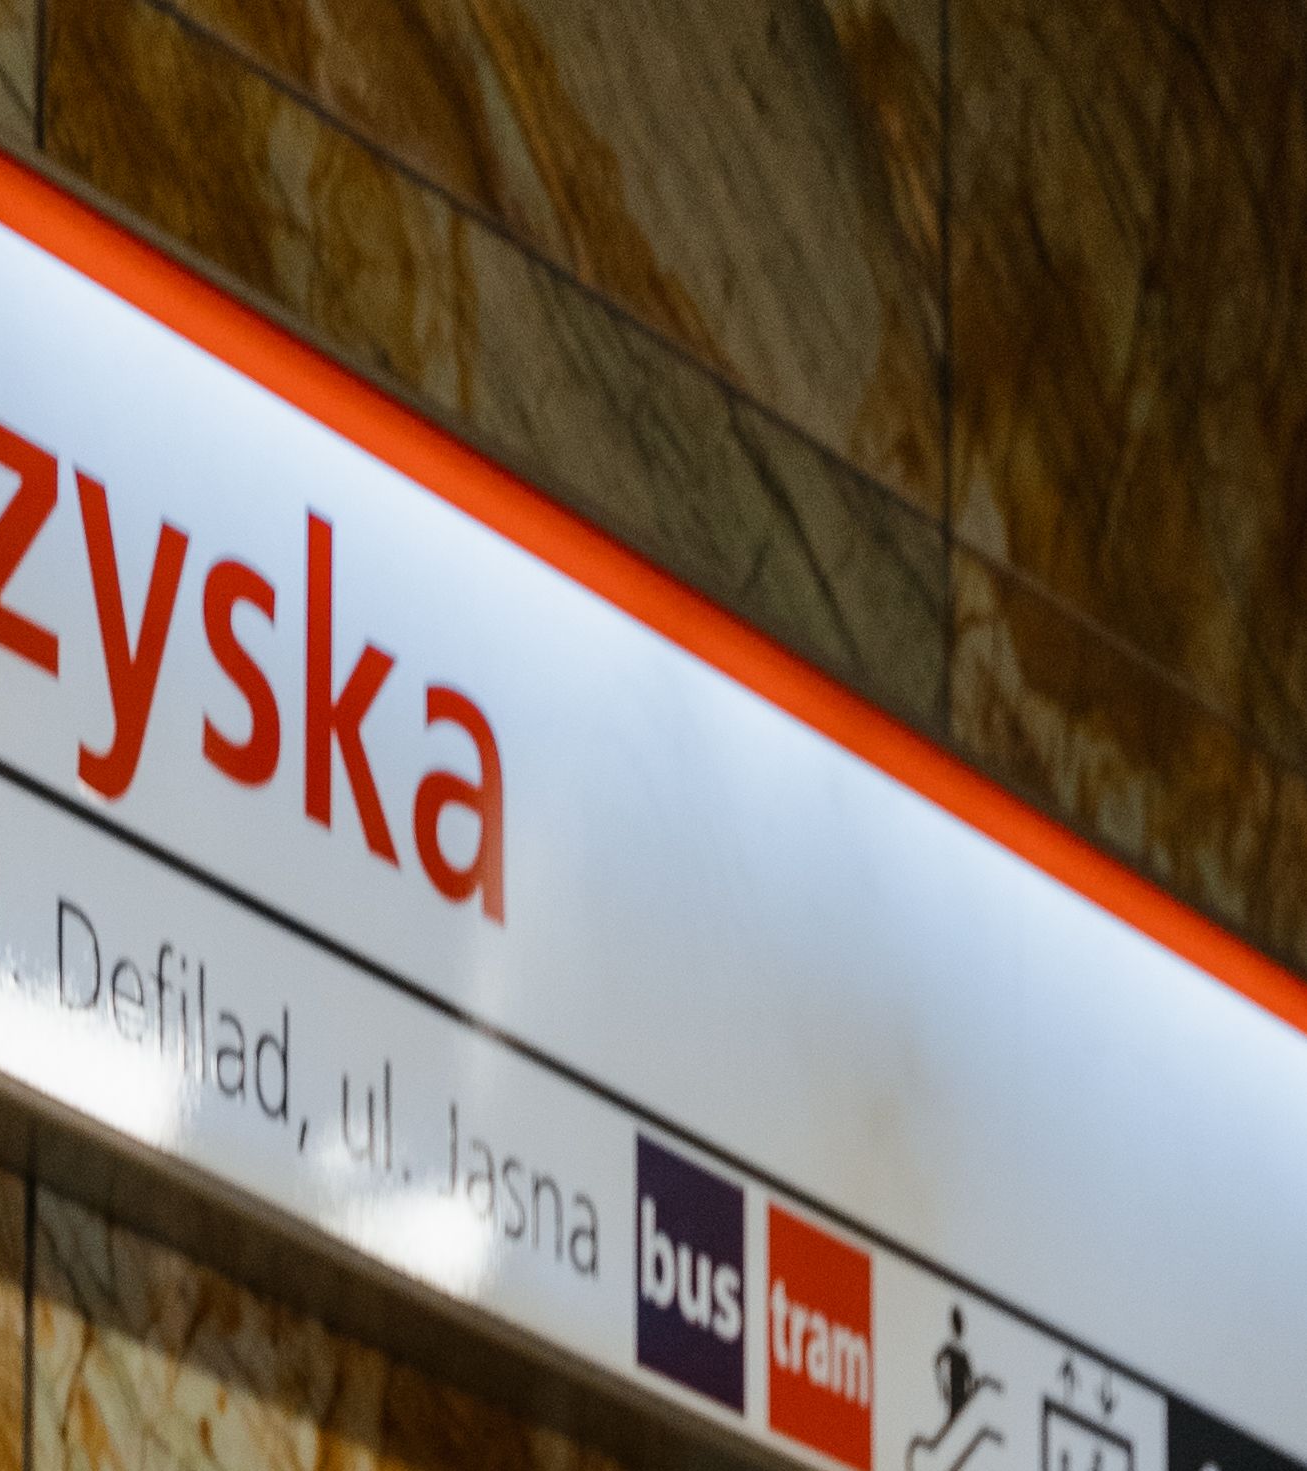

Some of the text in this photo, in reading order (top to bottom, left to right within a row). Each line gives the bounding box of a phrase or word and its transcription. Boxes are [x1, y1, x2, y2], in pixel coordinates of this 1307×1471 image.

[56, 895, 310, 1154] Defilad,
[342, 1060, 412, 1184] ul.
[441, 1100, 601, 1279] Jasna
[640, 1194, 744, 1344] bus
[770, 1278, 871, 1410] tram
